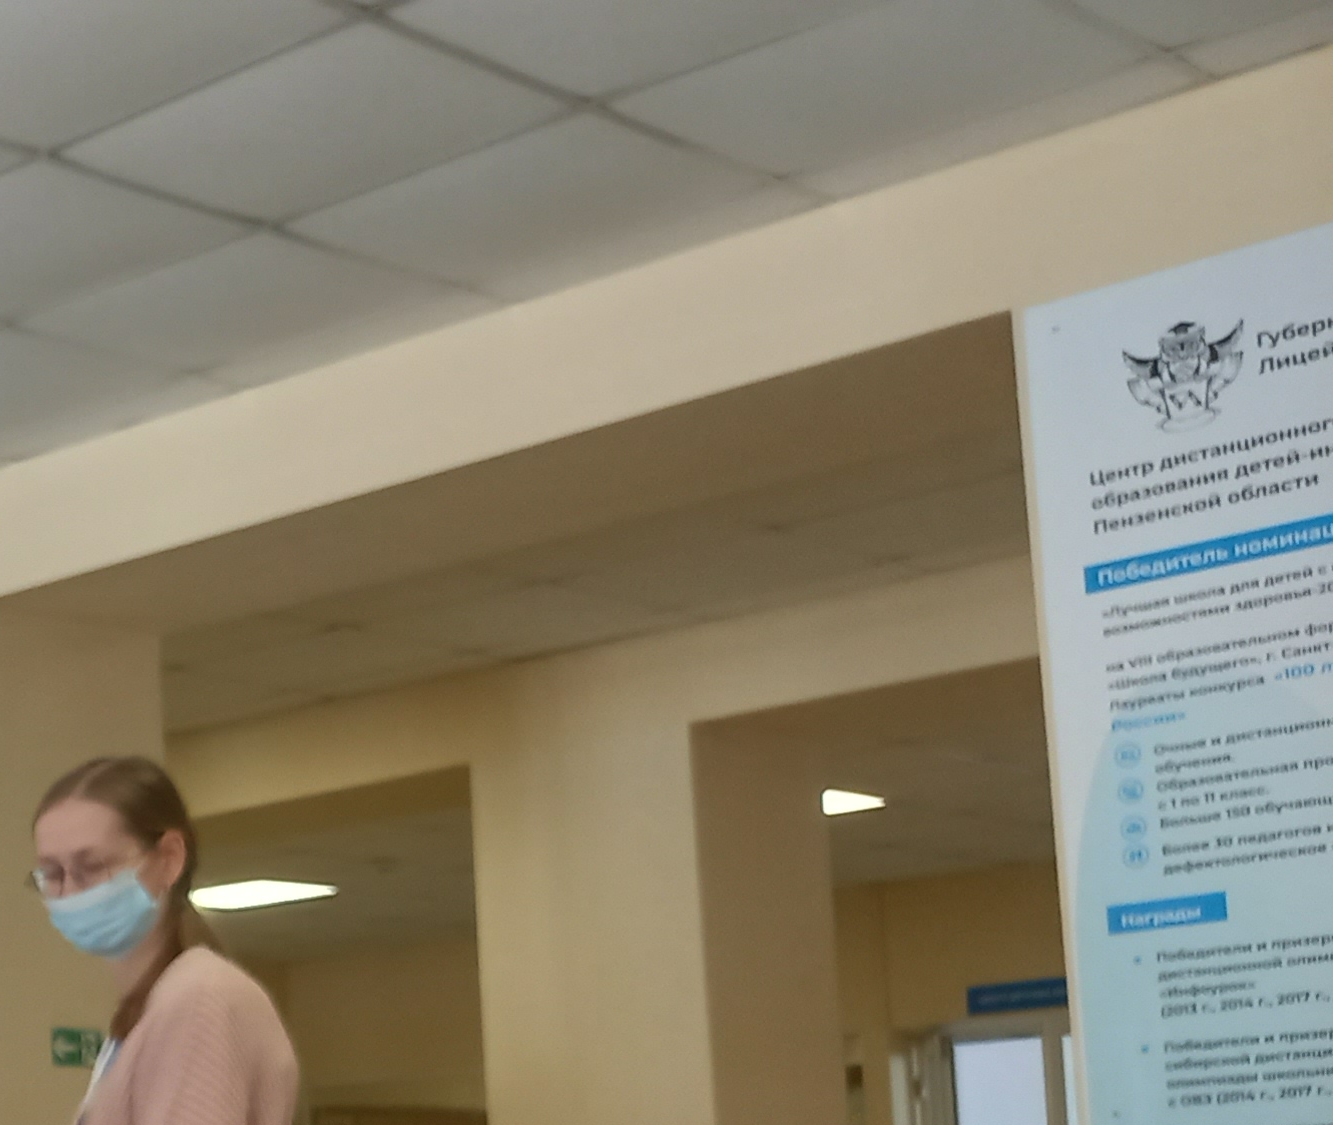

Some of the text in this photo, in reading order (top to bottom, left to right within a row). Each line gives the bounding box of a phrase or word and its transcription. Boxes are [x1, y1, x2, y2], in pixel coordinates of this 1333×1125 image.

[1259, 342, 1333, 375] Лицей
[1090, 461, 1154, 487] Центр
[1091, 468, 1229, 511] образования
[1094, 473, 1319, 535] Пензенской области
[1098, 547, 1229, 587] Победитель
[1173, 586, 1225, 606] школа
[1230, 578, 1260, 596] для
[1263, 566, 1314, 588] детей
[1102, 604, 1231, 638] возможностями
[1156, 628, 1300, 665] образовательном
[1108, 671, 1167, 692] «Школа
[1110, 691, 1185, 712] Лауреаты
[1190, 675, 1265, 699] конкурса
[1211, 735, 1221, 747] и
[1156, 761, 1299, 792] Образовательная
[1204, 791, 1216, 805] 11
[1159, 810, 1221, 829] Больше
[1162, 841, 1210, 857] Более
[1237, 824, 1322, 846] педагогов
[1121, 906, 1202, 929] Награды
[1256, 941, 1267, 952] и
[1264, 1033, 1275, 1044] и
